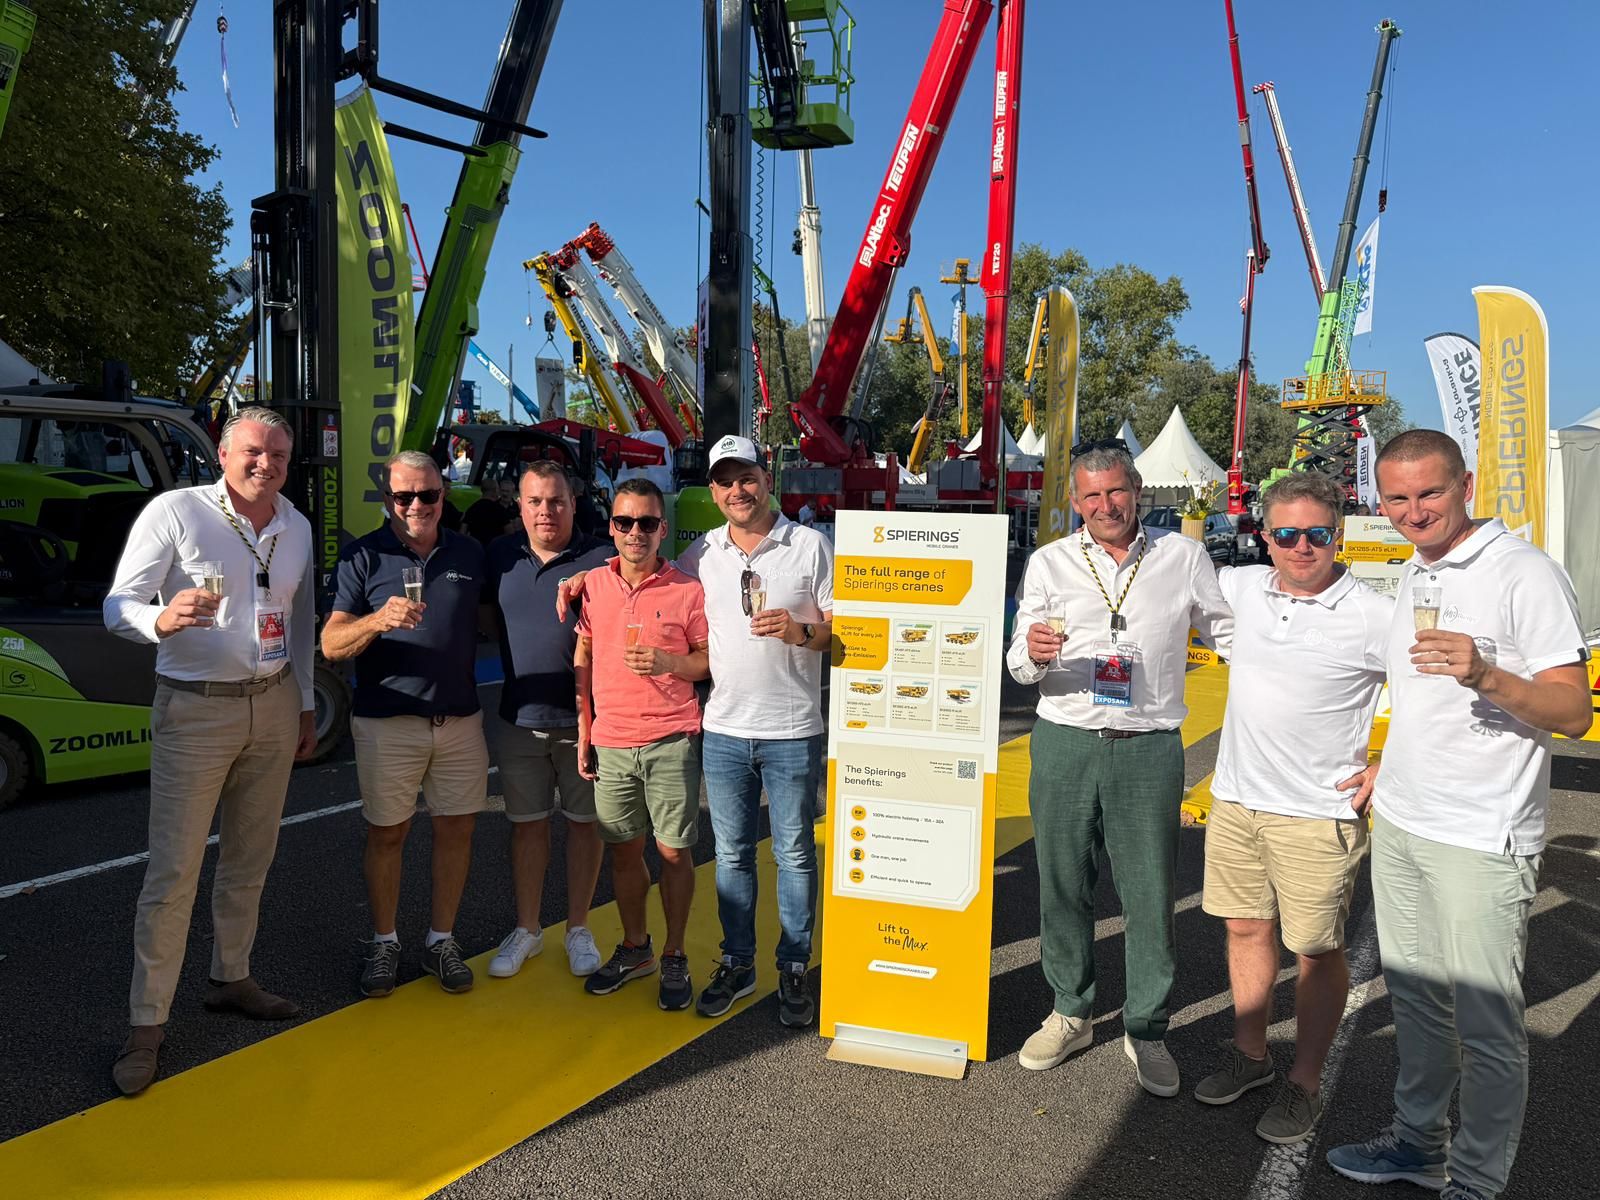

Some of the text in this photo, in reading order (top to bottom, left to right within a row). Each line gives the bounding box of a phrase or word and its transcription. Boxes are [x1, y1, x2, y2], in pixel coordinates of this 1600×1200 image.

[993, 70, 1008, 165] Altec TEUPEN
[866, 120, 920, 257] Altec TEUPEN
[992, 242, 1001, 275] TE720
[323, 466, 338, 569] ZOOMLION
[886, 529, 960, 543] SPIERINGS
[844, 565, 947, 581] The full range of
[844, 578, 944, 592] Spierings cranes
[2, 638, 25, 651] 25A
[846, 765, 907, 779] The Spierings
[844, 776, 883, 787] benefits:
[878, 922, 910, 935] Lift to
[884, 935, 900, 946] the
